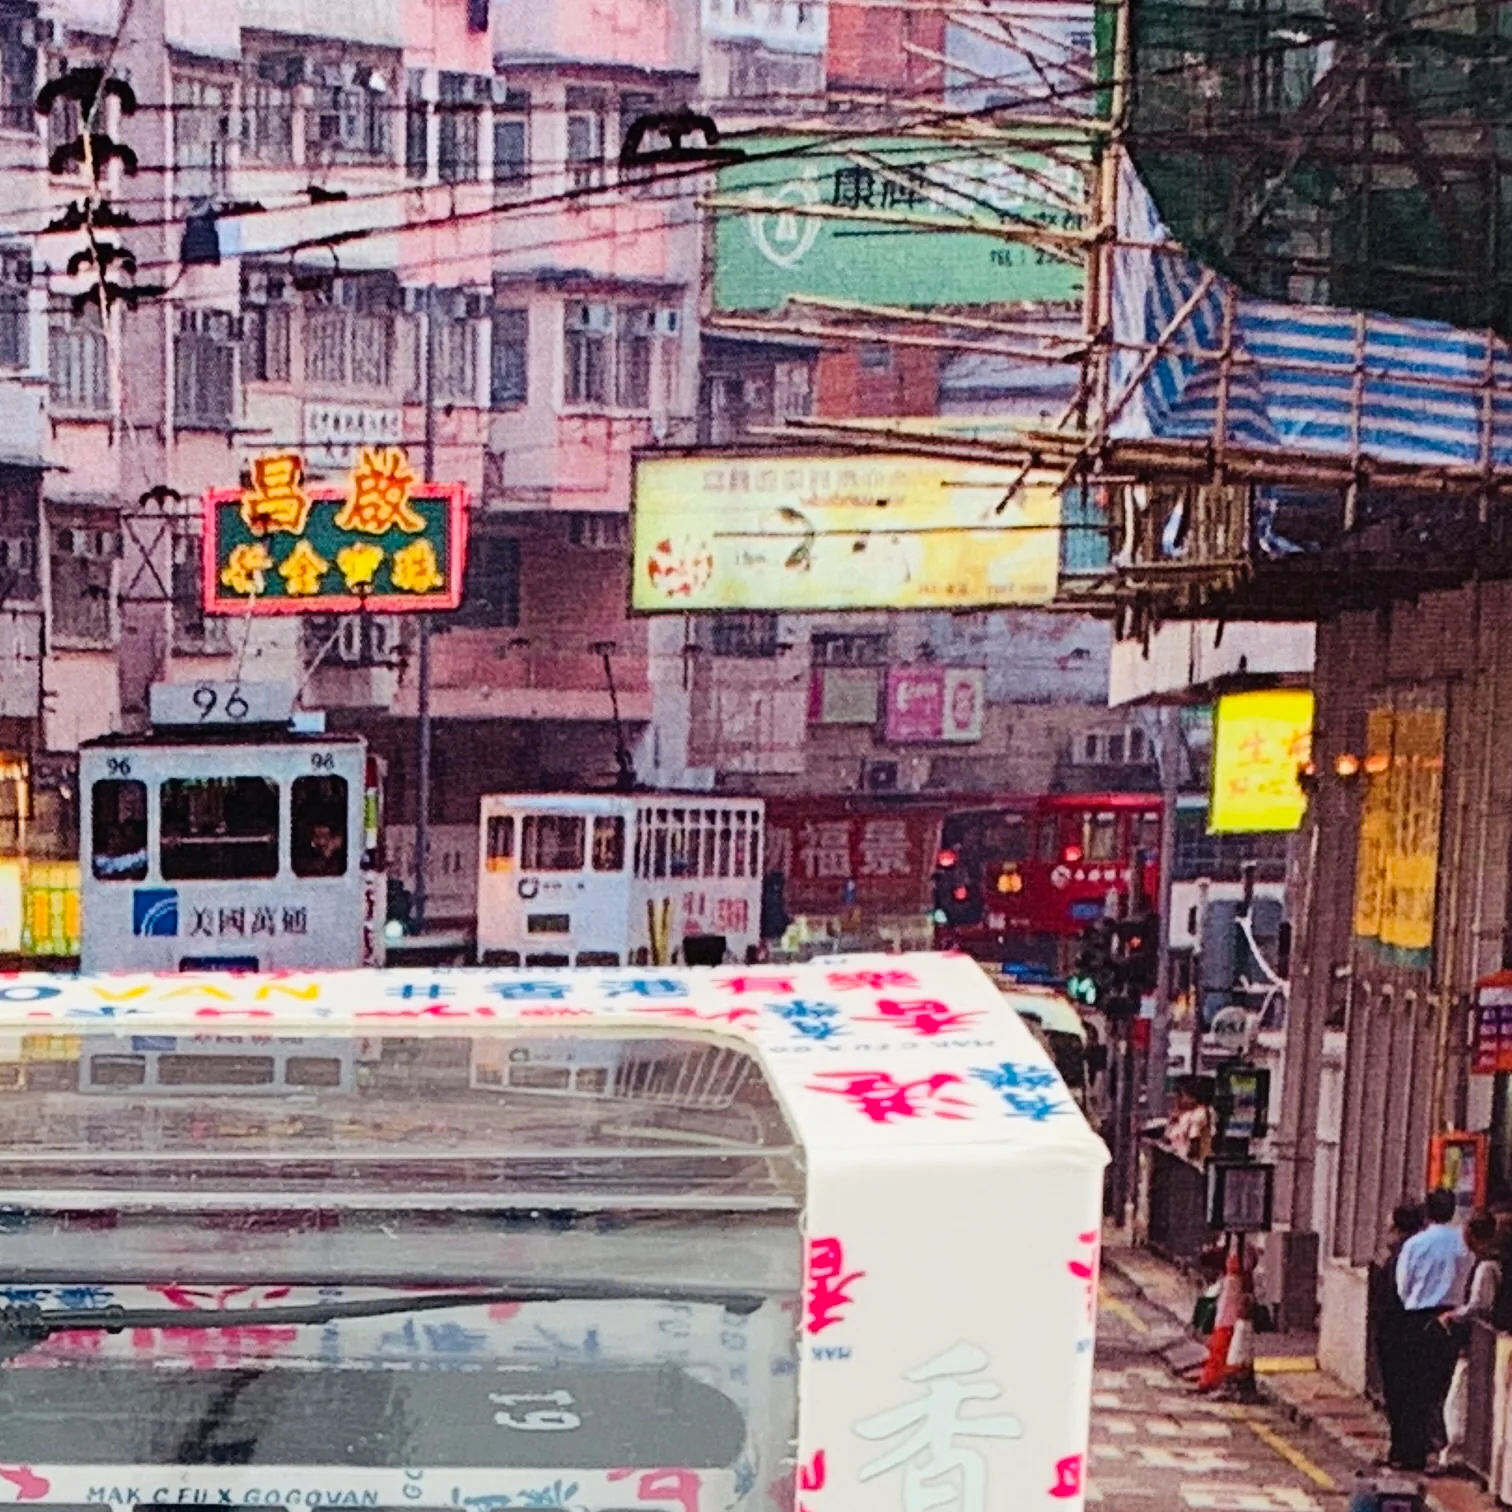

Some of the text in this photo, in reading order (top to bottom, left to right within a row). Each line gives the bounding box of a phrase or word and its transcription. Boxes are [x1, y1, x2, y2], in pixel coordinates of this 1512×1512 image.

[192, 684, 250, 721] 96
[86, 1485, 380, 1508] MAK C FU X GOGOVAN
